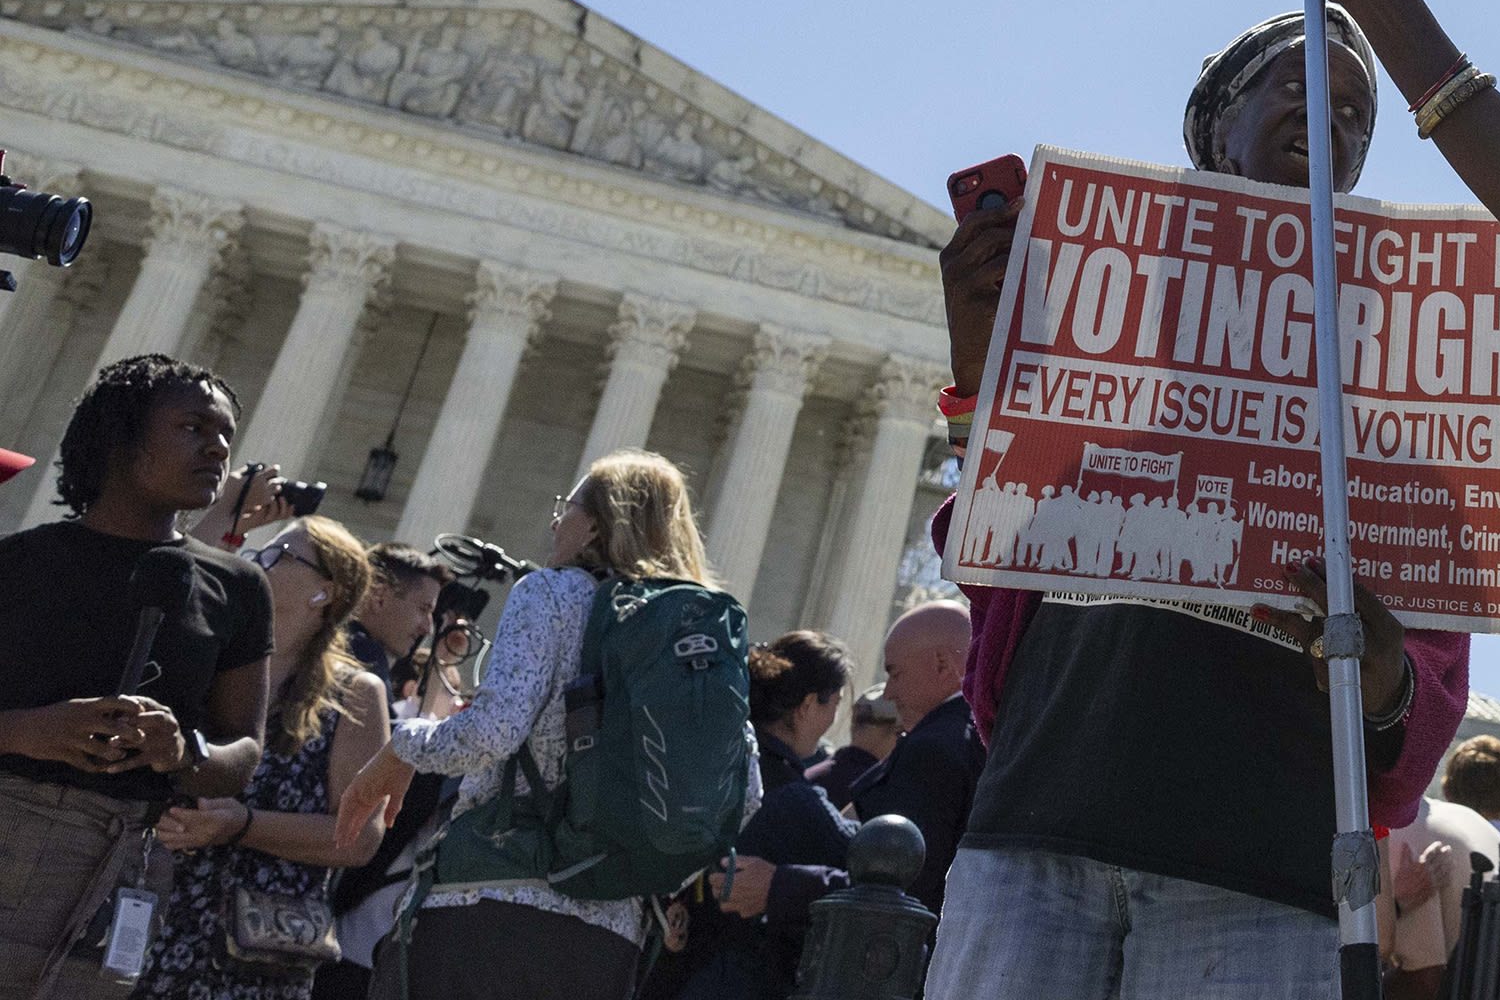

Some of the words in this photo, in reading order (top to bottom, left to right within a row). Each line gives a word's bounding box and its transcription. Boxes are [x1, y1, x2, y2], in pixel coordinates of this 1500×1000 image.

[1056, 179, 1219, 257] UNITE
[1235, 205, 1305, 269] TO
[1019, 236, 1316, 379] VOTING
[1006, 361, 1146, 426] EVERY
[1147, 378, 1265, 442] ISSUE
[1270, 393, 1309, 446] IS
[1352, 405, 1493, 464] VOTING
[1088, 453, 1122, 472] UNITE
[1123, 456, 1139, 473] TO
[1140, 458, 1174, 476] FIGHT
[1247, 461, 1323, 497] Labor,
[1347, 475, 1456, 511] ducation,
[1197, 479, 1229, 495] VOTE
[1247, 501, 1325, 539] Women,
[1348, 519, 1453, 554] overnment,
[1399, 560, 1441, 584] and
[1253, 577, 1284, 591] SOS
[1407, 596, 1469, 613] JUSTICE
[1472, 601, 1484, 613] &
[1203, 603, 1251, 628] CHANGE
[1248, 618, 1272, 636] you
